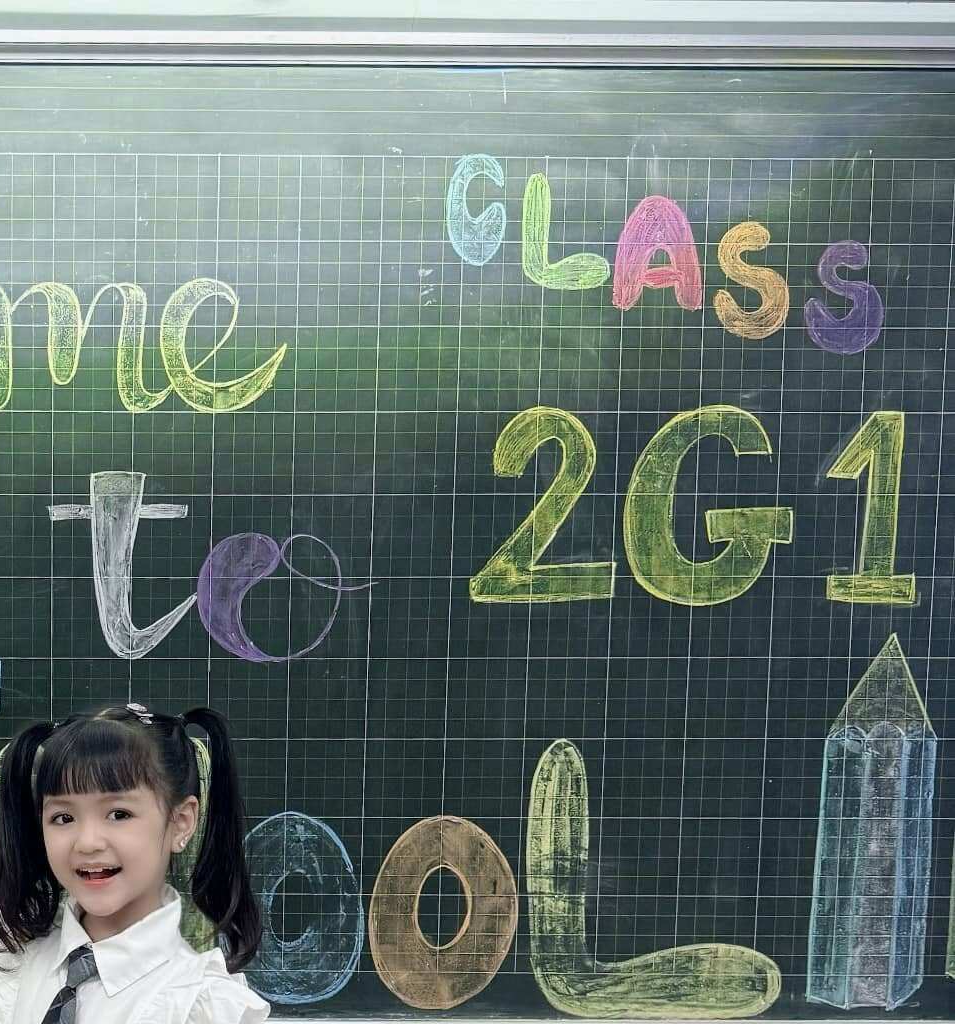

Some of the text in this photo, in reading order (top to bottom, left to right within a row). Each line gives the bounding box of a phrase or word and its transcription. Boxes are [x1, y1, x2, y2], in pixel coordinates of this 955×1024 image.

[446, 153, 885, 355] CLASS
[48, 471, 379, 662] to
[469, 404, 920, 607] 2G1
